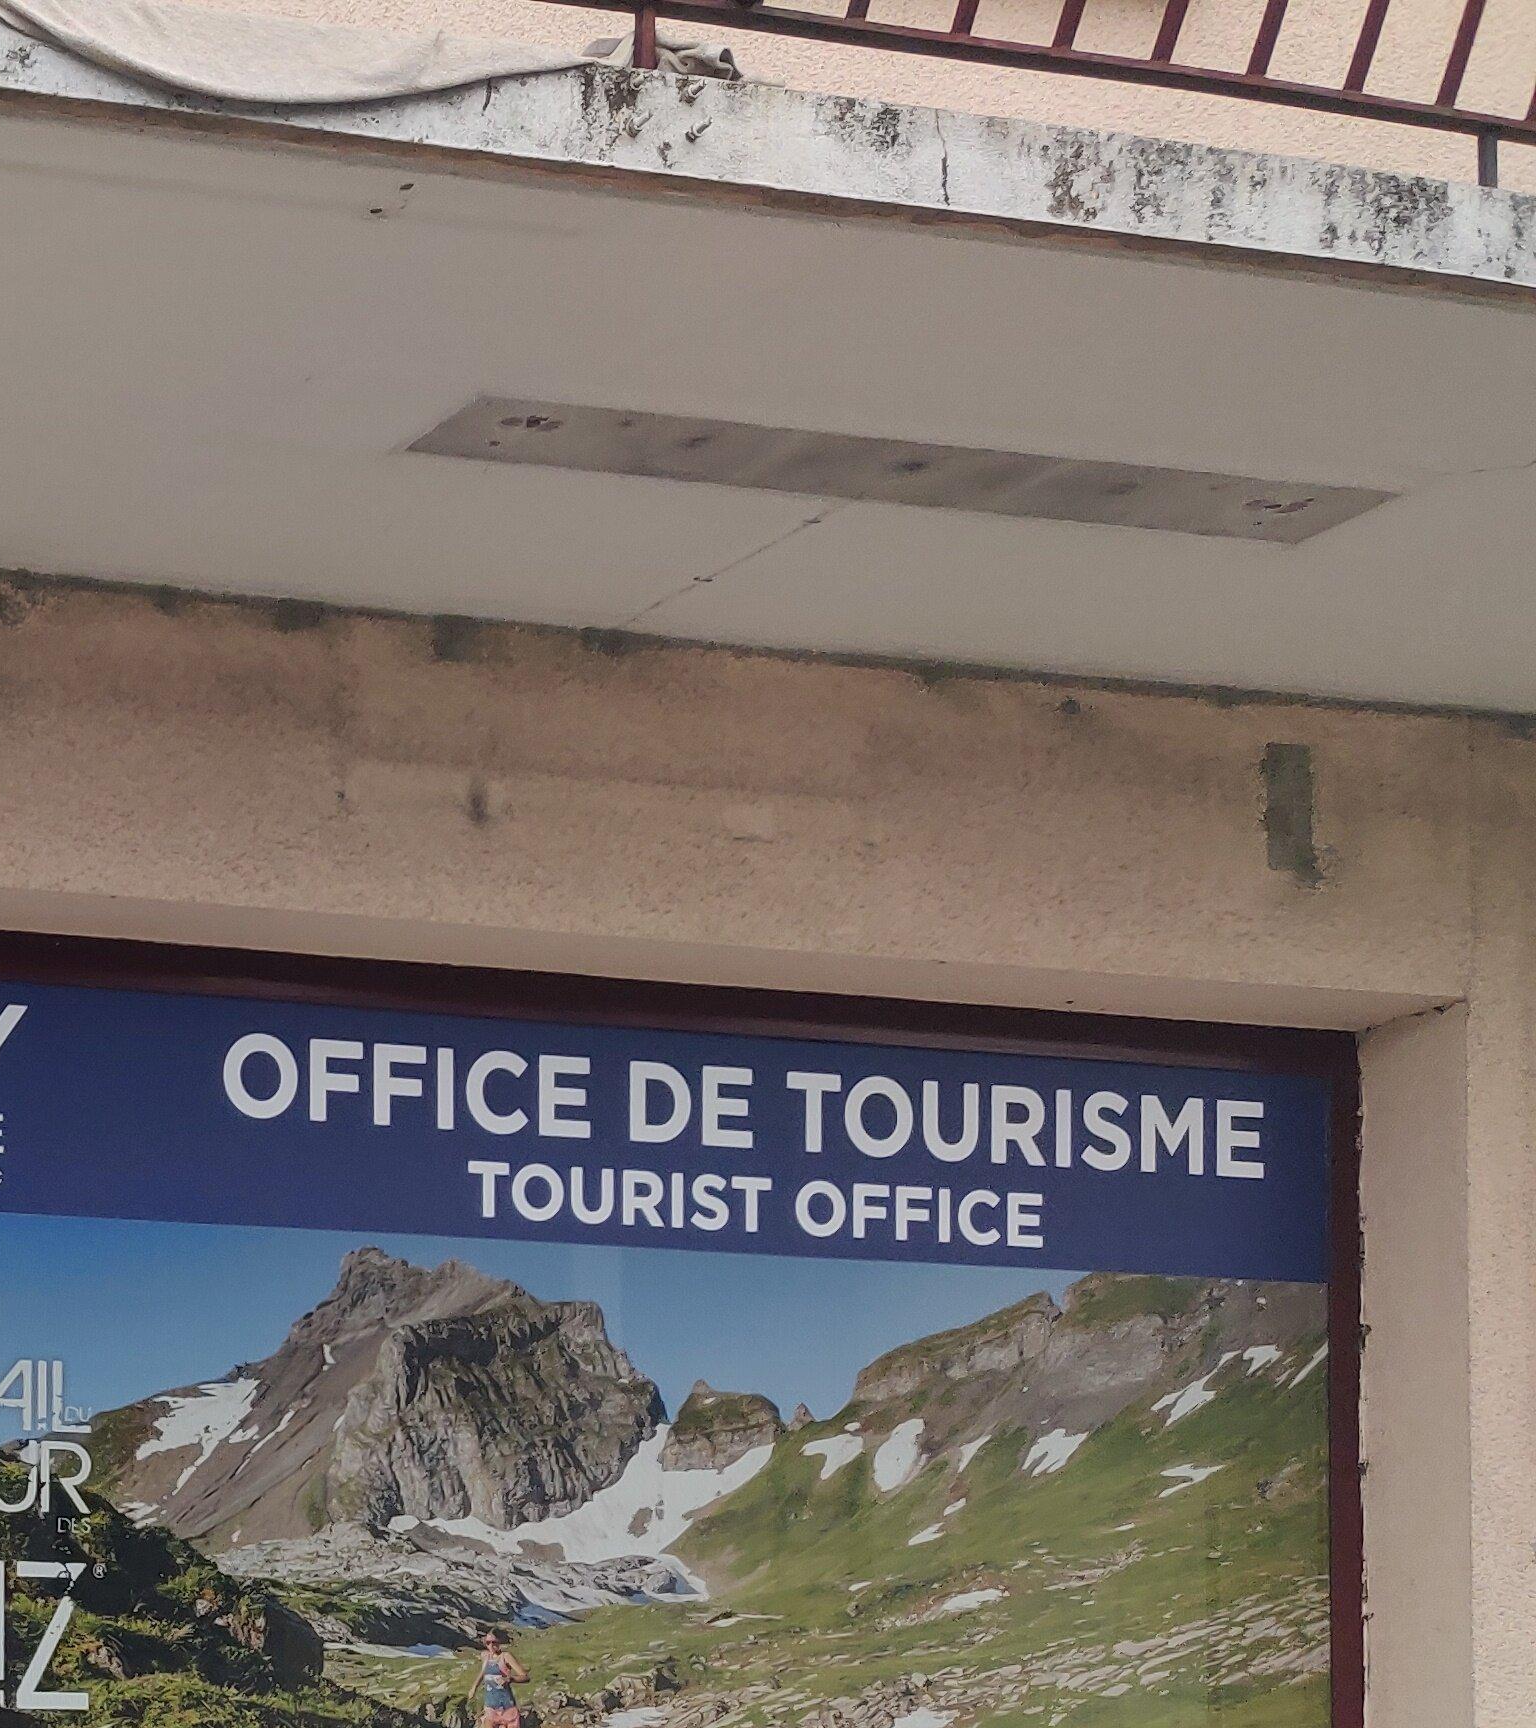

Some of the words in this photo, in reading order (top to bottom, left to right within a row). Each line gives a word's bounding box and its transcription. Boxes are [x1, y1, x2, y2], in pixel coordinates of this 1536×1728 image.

[222, 1031, 592, 1140] OFFICE
[629, 1059, 754, 1149] DE
[785, 1069, 1266, 1180] TOURISME
[466, 1159, 771, 1233] TOURIST
[793, 1179, 1044, 1250] OFFICE
[56, 1516, 91, 1534] DES
